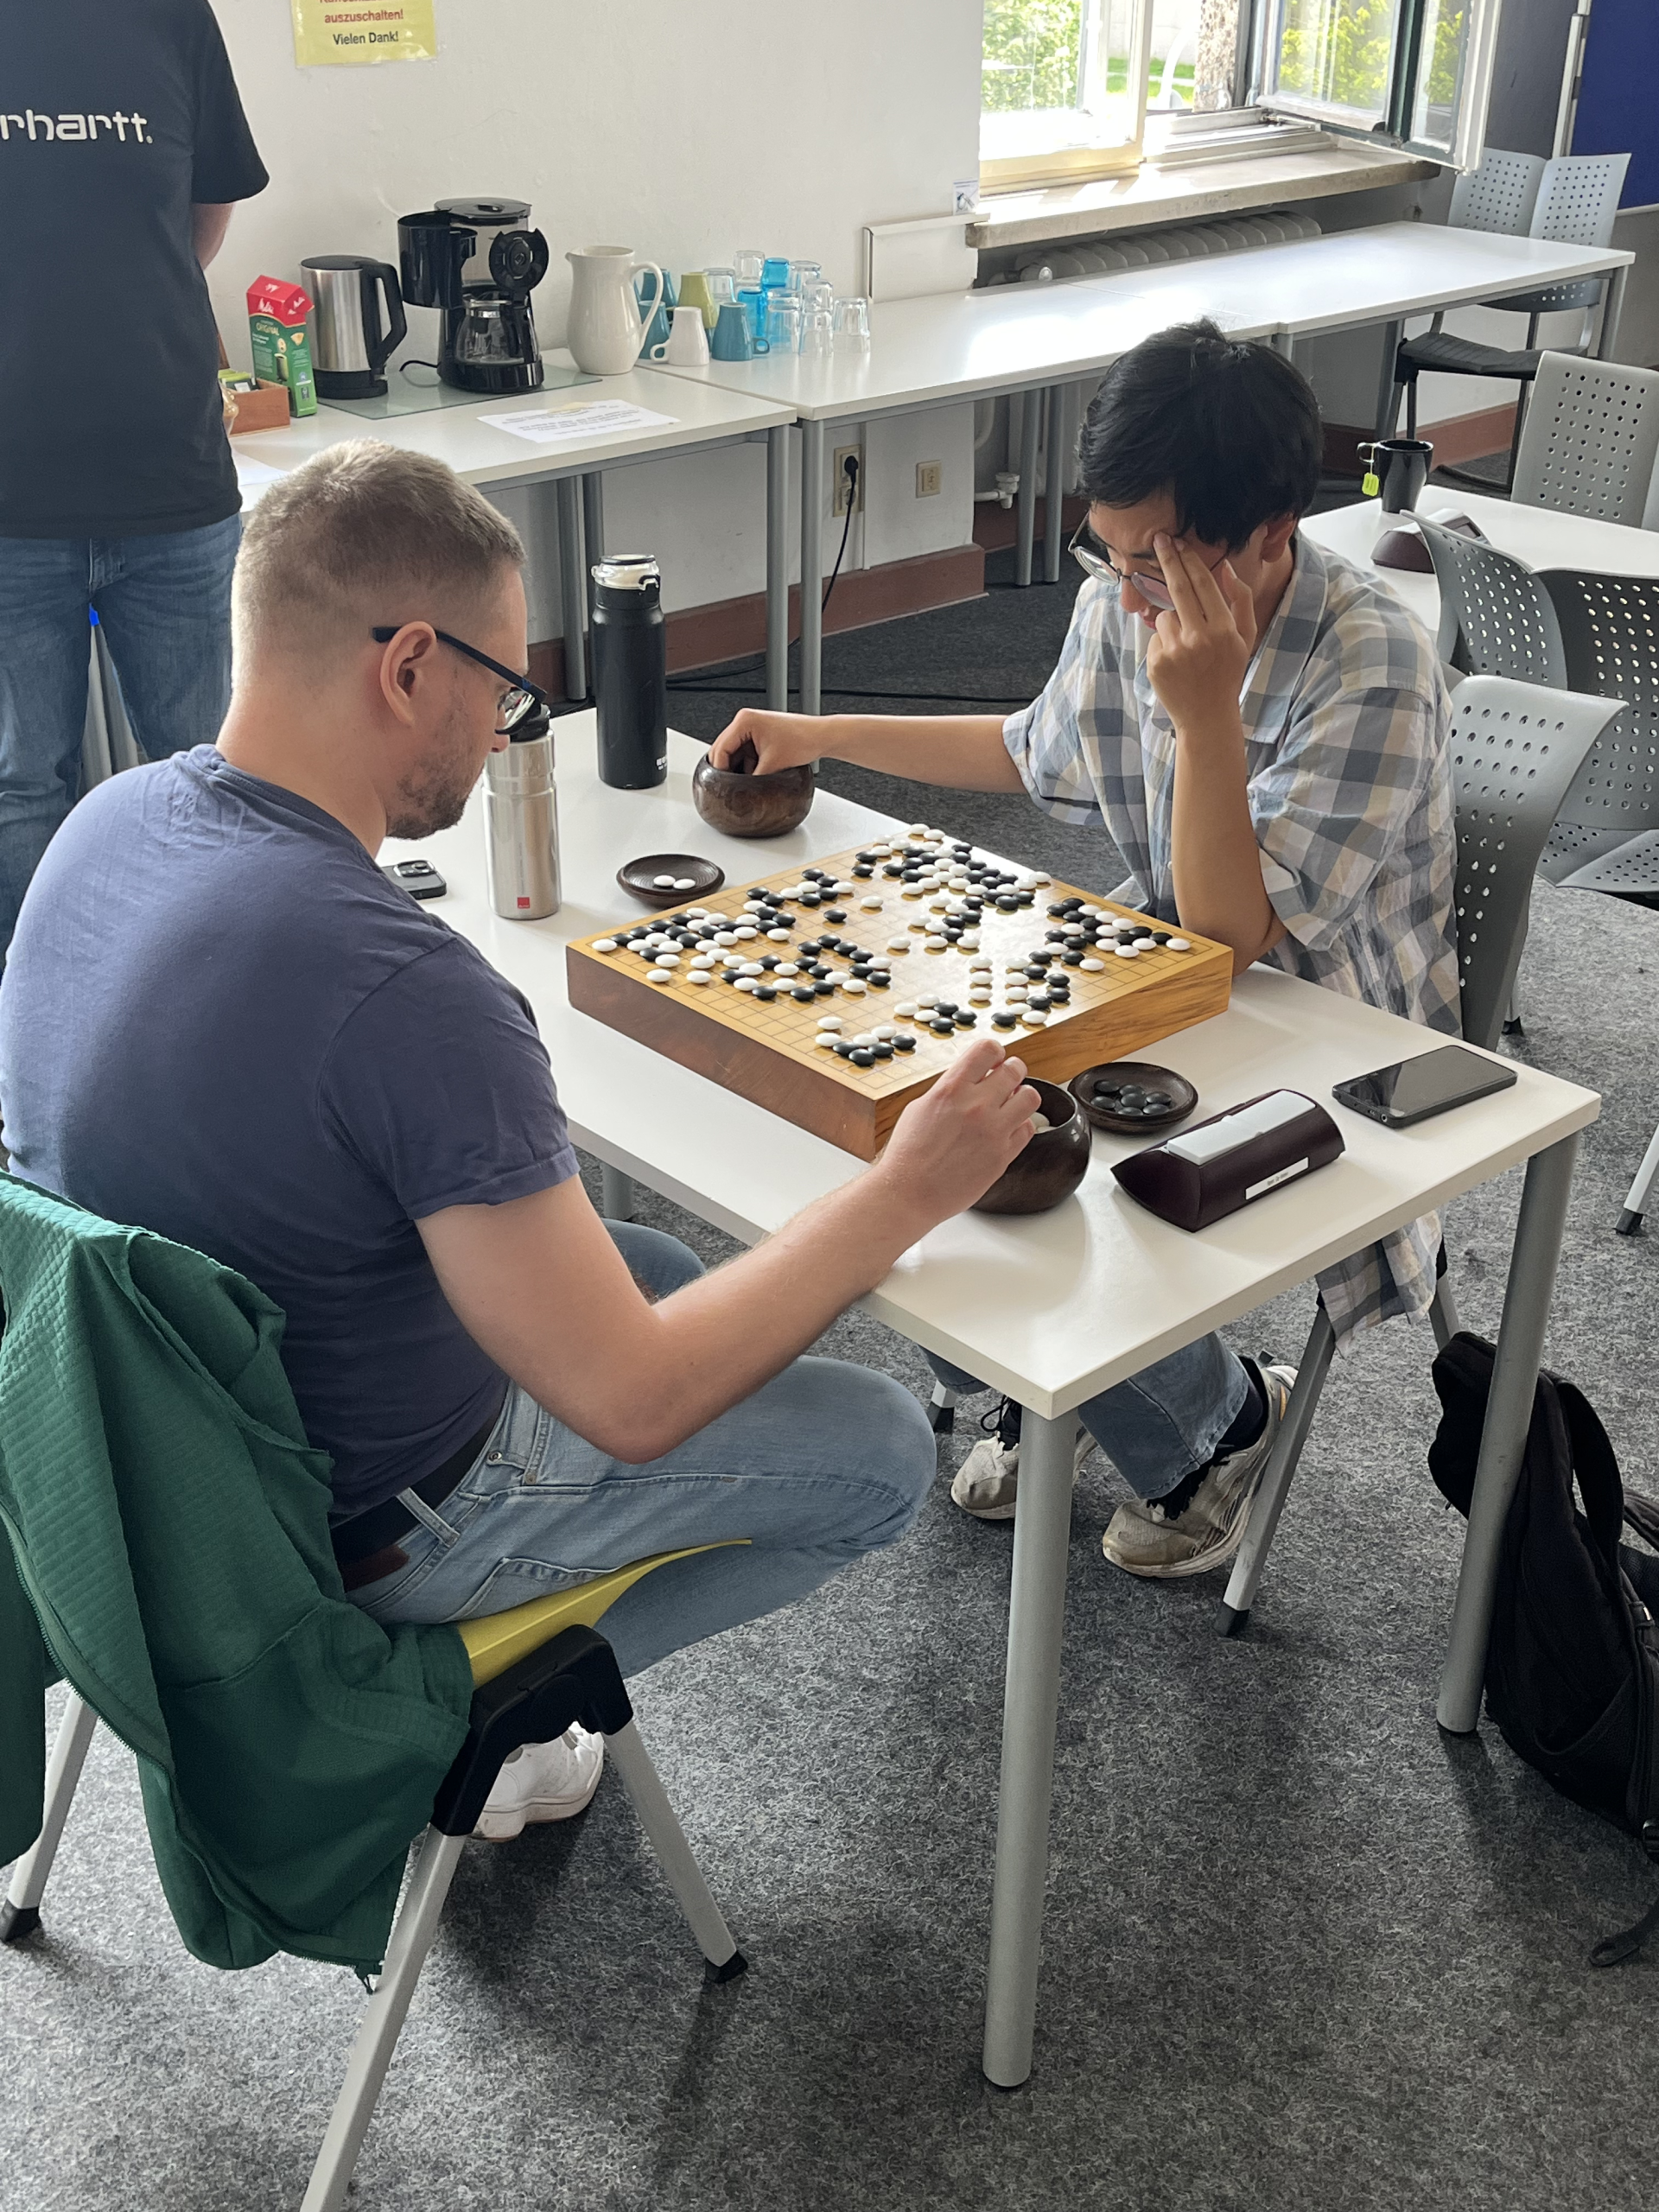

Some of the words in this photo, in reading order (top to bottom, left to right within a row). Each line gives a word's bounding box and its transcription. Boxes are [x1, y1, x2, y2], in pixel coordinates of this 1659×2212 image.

[324, 9, 404, 23] auszuschalten!
[333, 33, 366, 45] Vielen
[368, 31, 399, 43] Dank!
